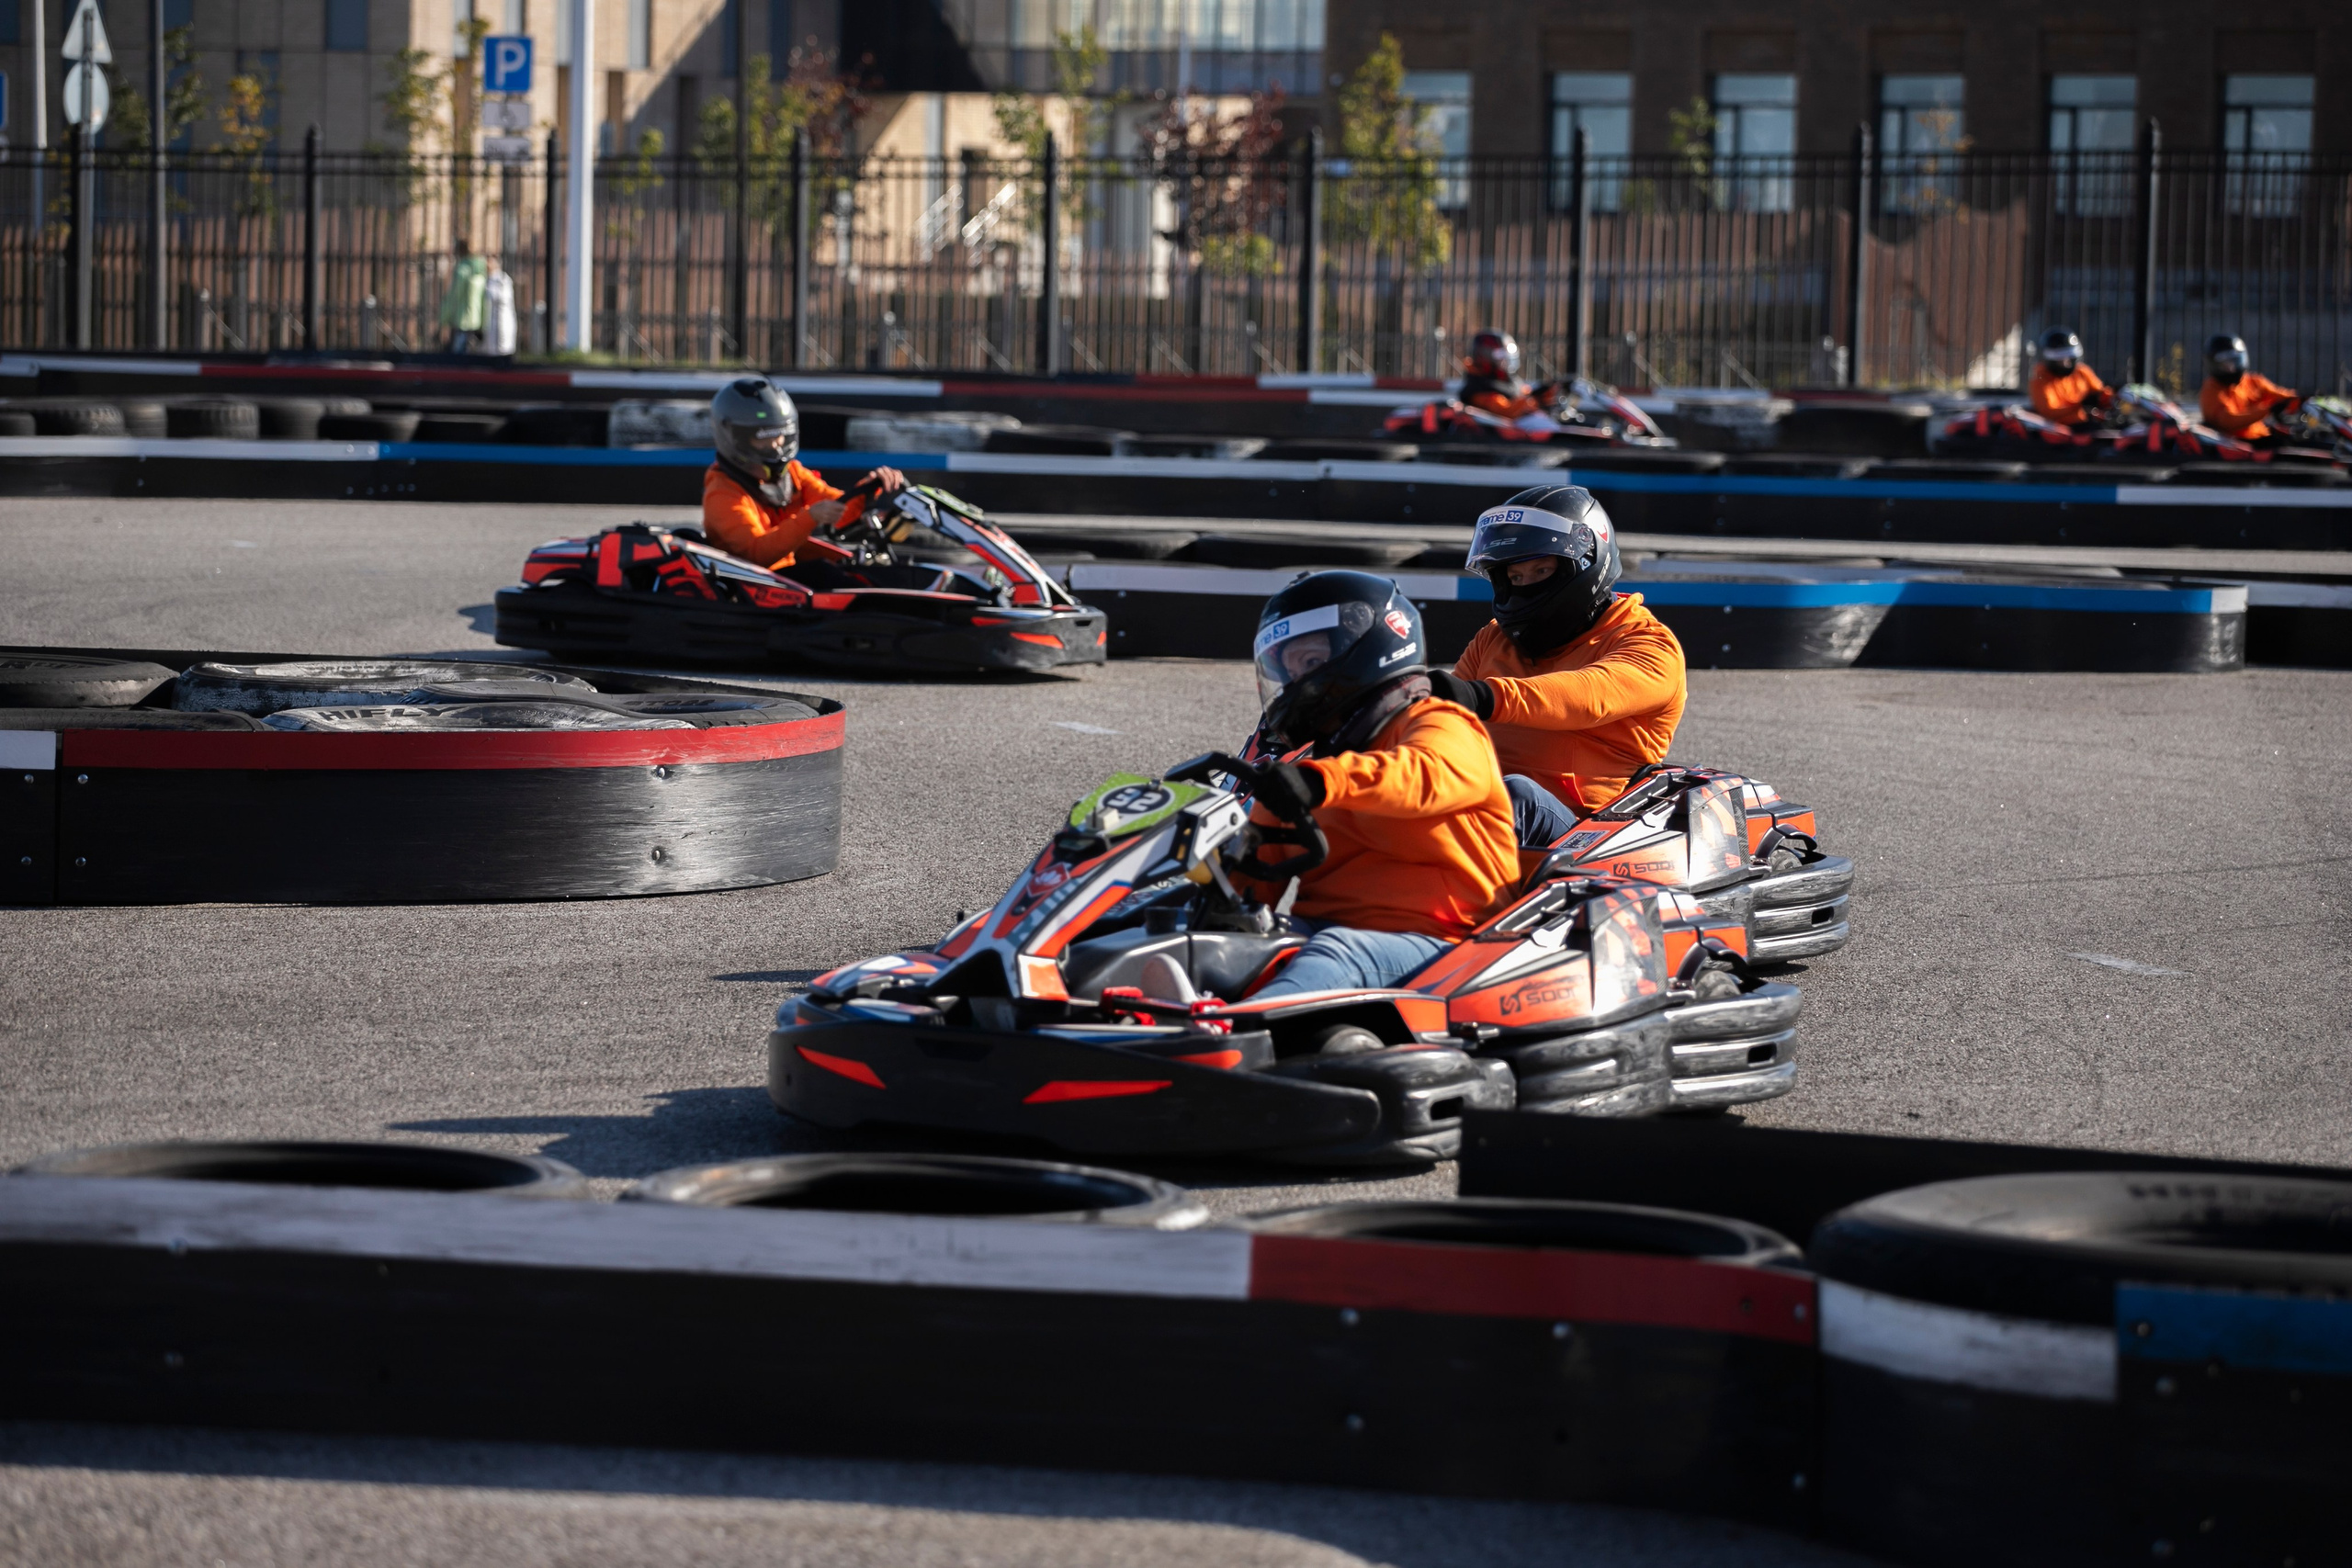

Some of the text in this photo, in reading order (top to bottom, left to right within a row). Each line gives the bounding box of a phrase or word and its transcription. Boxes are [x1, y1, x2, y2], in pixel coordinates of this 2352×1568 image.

[495, 41, 526, 87] P
[1508, 511, 1522, 522] 39
[1274, 622, 1288, 637] 39
[1379, 642, 1417, 668] LS2
[318, 706, 463, 722] HIFLY
[1107, 788, 1162, 811] 32
